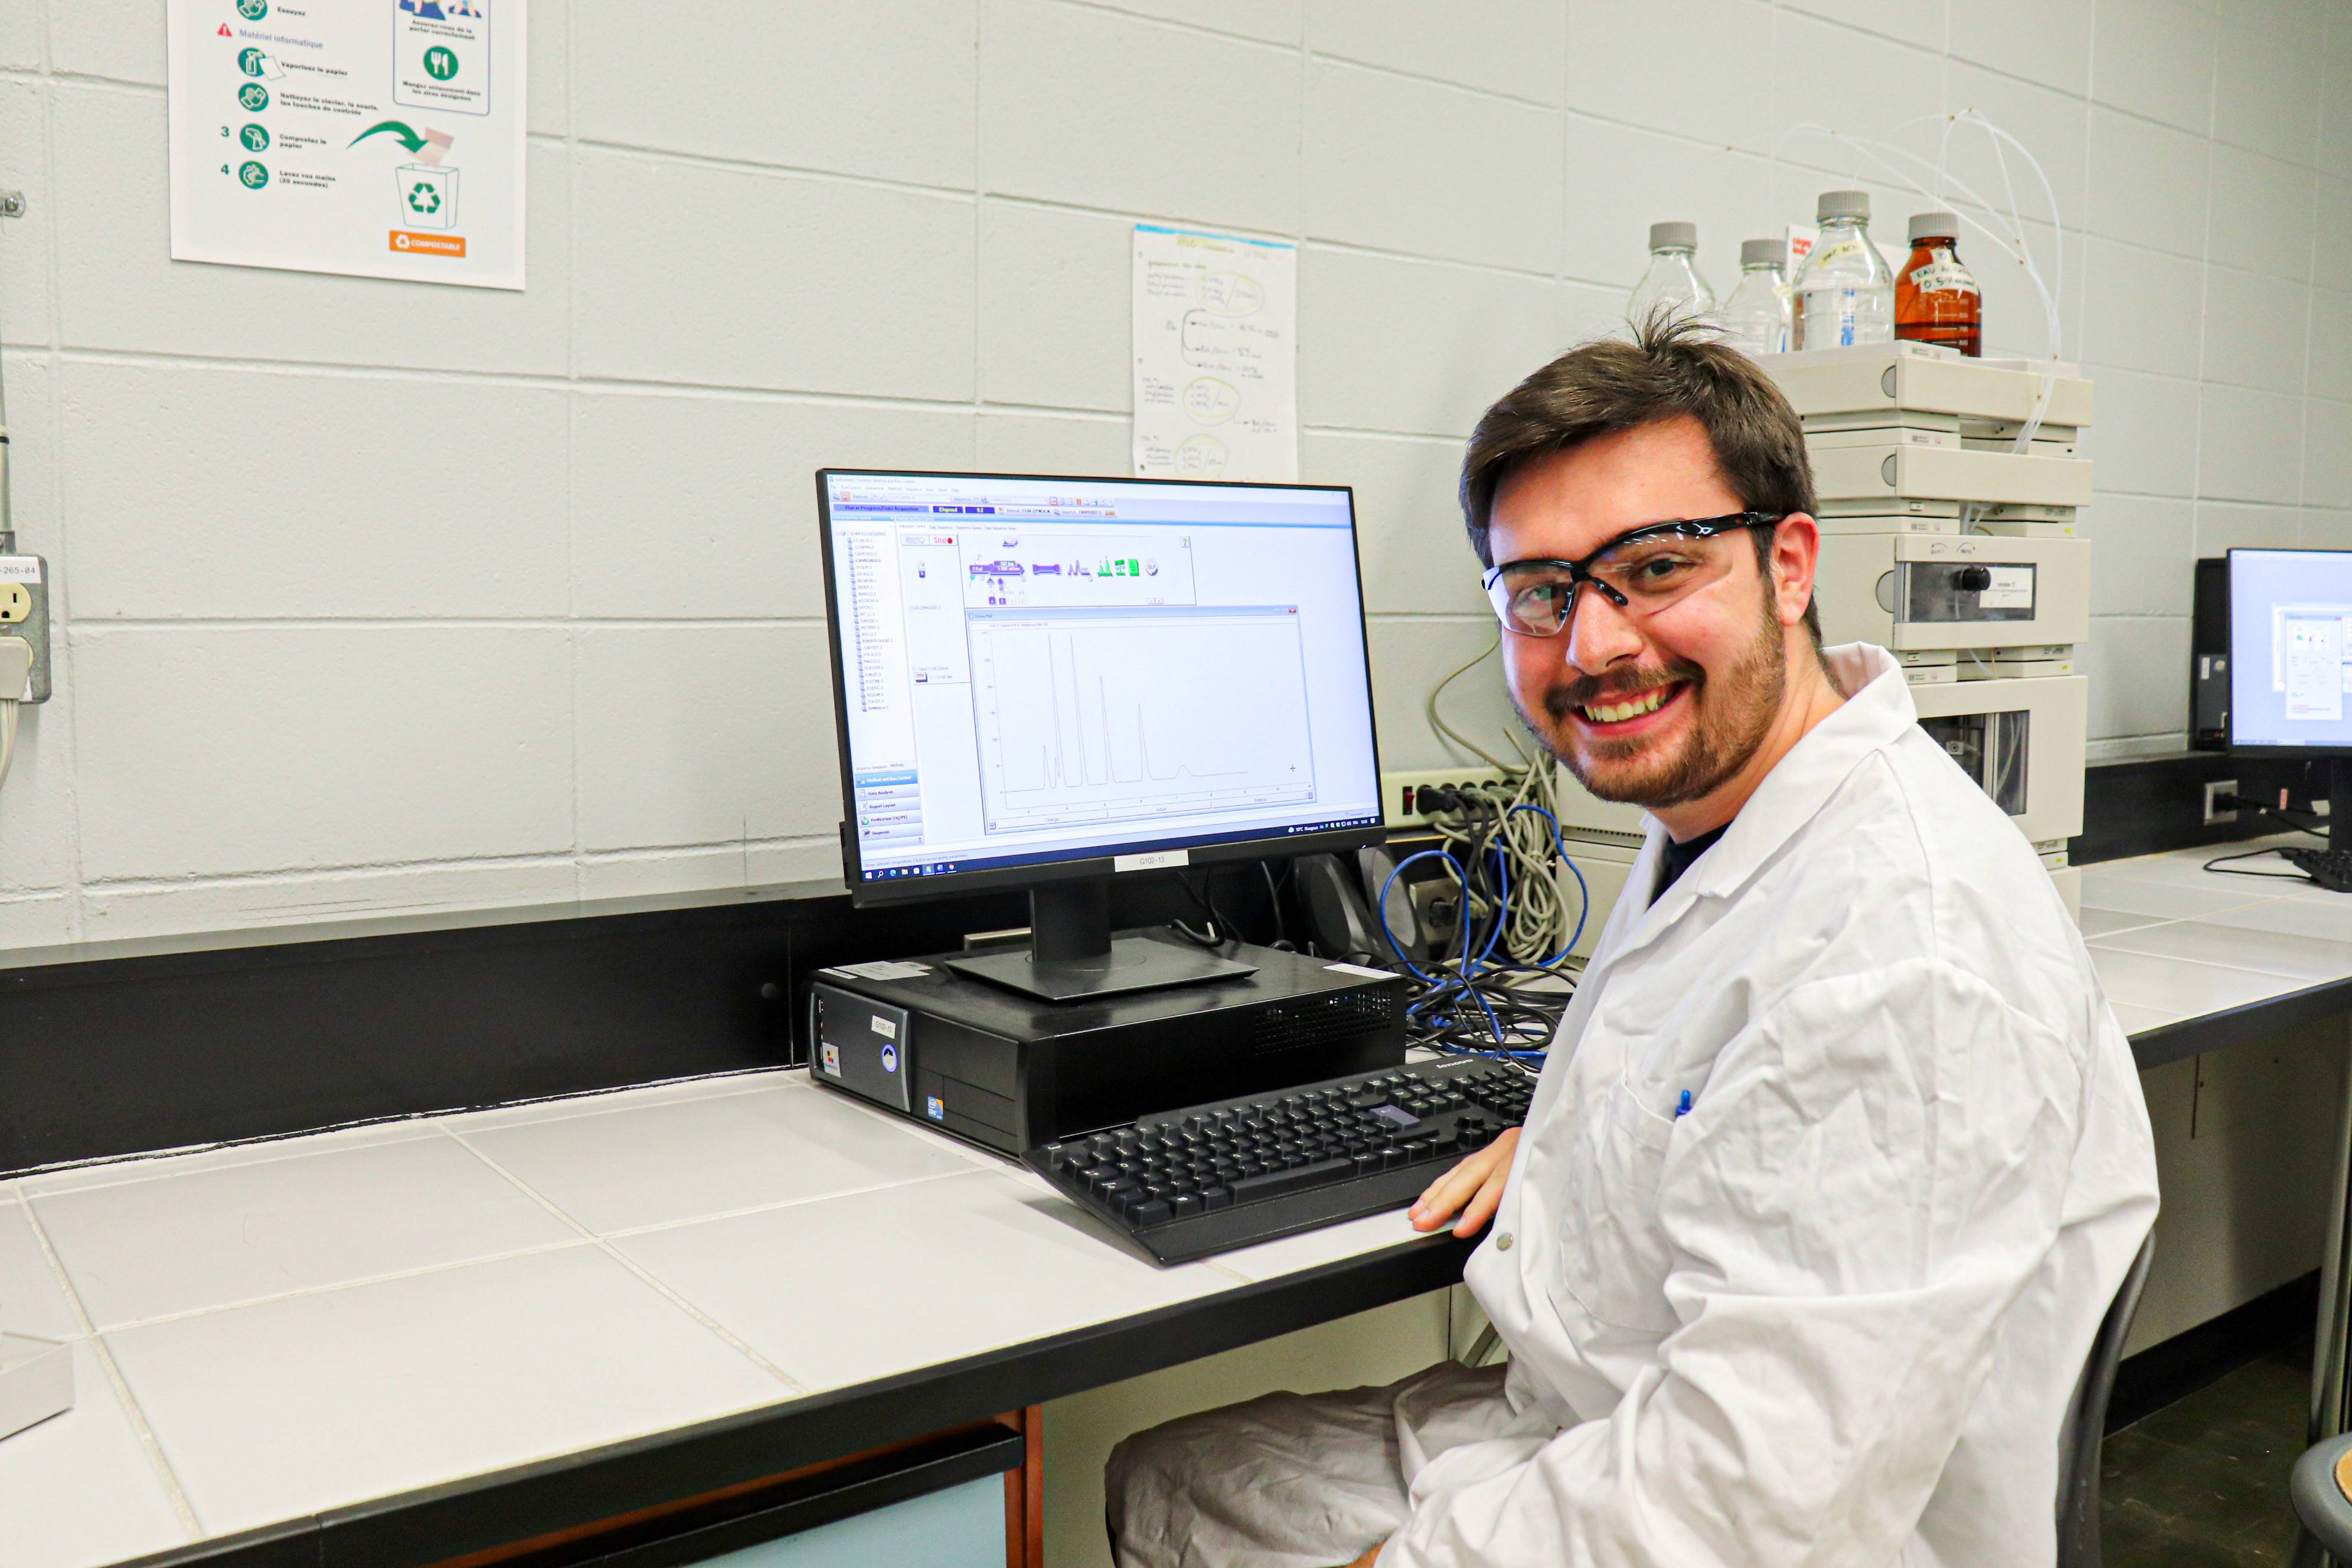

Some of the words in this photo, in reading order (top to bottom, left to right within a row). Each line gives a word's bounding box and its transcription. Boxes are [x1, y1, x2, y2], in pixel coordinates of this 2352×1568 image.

[277, 6, 306, 17] Essuyez
[239, 29, 272, 41] Matériel
[274, 35, 324, 49] informatique
[281, 61, 316, 71] Vaporisez
[325, 68, 348, 76] papier
[221, 126, 230, 137] 3
[279, 134, 319, 145] Compostez
[221, 164, 230, 175] 4
[293, 179, 328, 188] secondes)
[411, 239, 461, 251] COMPOSTABLE
[1139, 855, 1165, 865] G102-13
[876, 1021, 893, 1033] G102-13
[1436, 1058, 1474, 1069] lenovo
